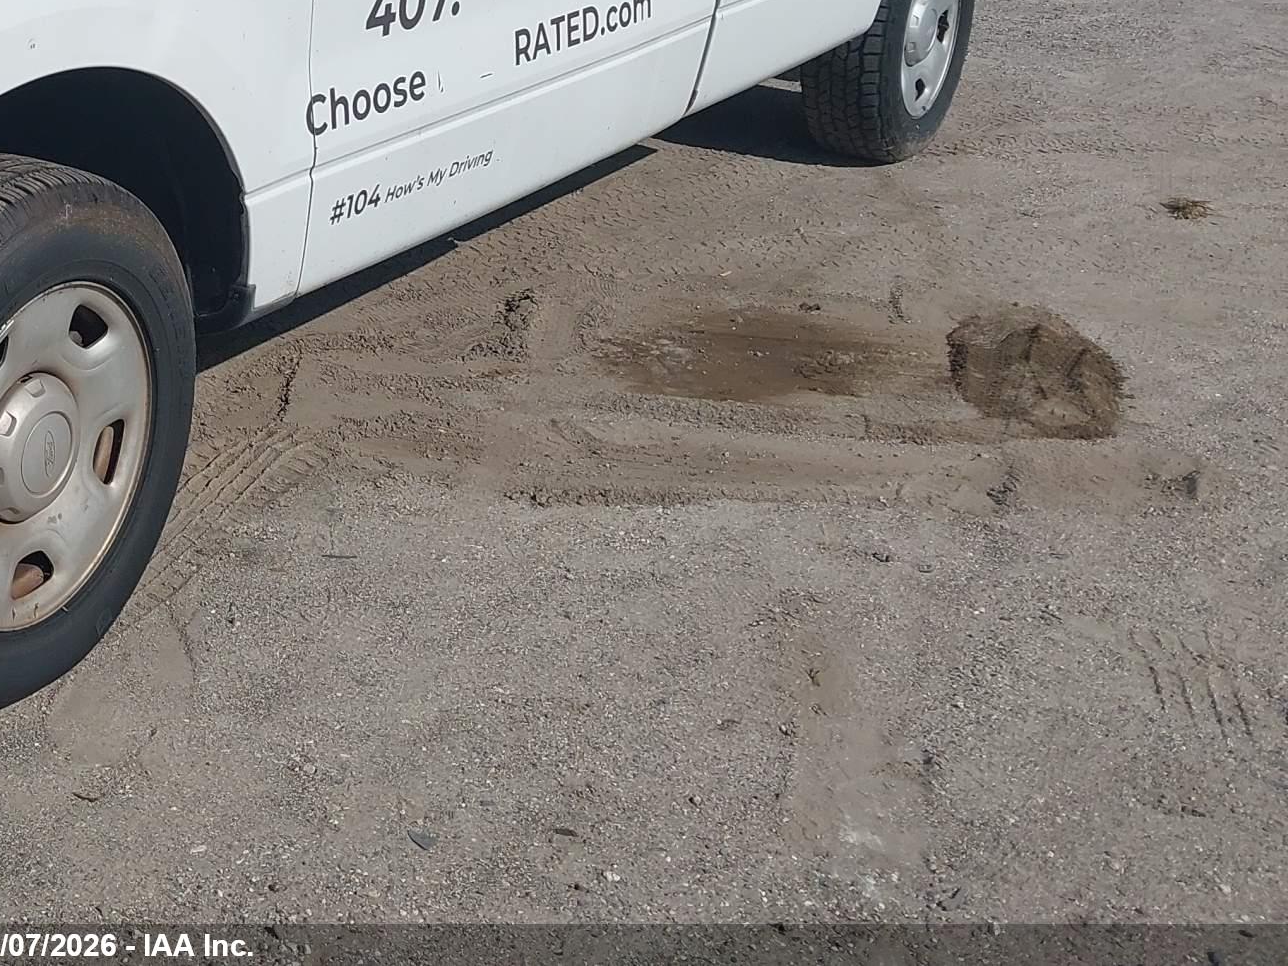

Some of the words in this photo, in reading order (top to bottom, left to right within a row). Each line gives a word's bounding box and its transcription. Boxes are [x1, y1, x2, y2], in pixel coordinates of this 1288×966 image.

[305, 71, 426, 135] Choose
[330, 184, 381, 224] #104
[385, 175, 425, 203] How's
[427, 166, 447, 186] My
[449, 149, 493, 177] Driving
